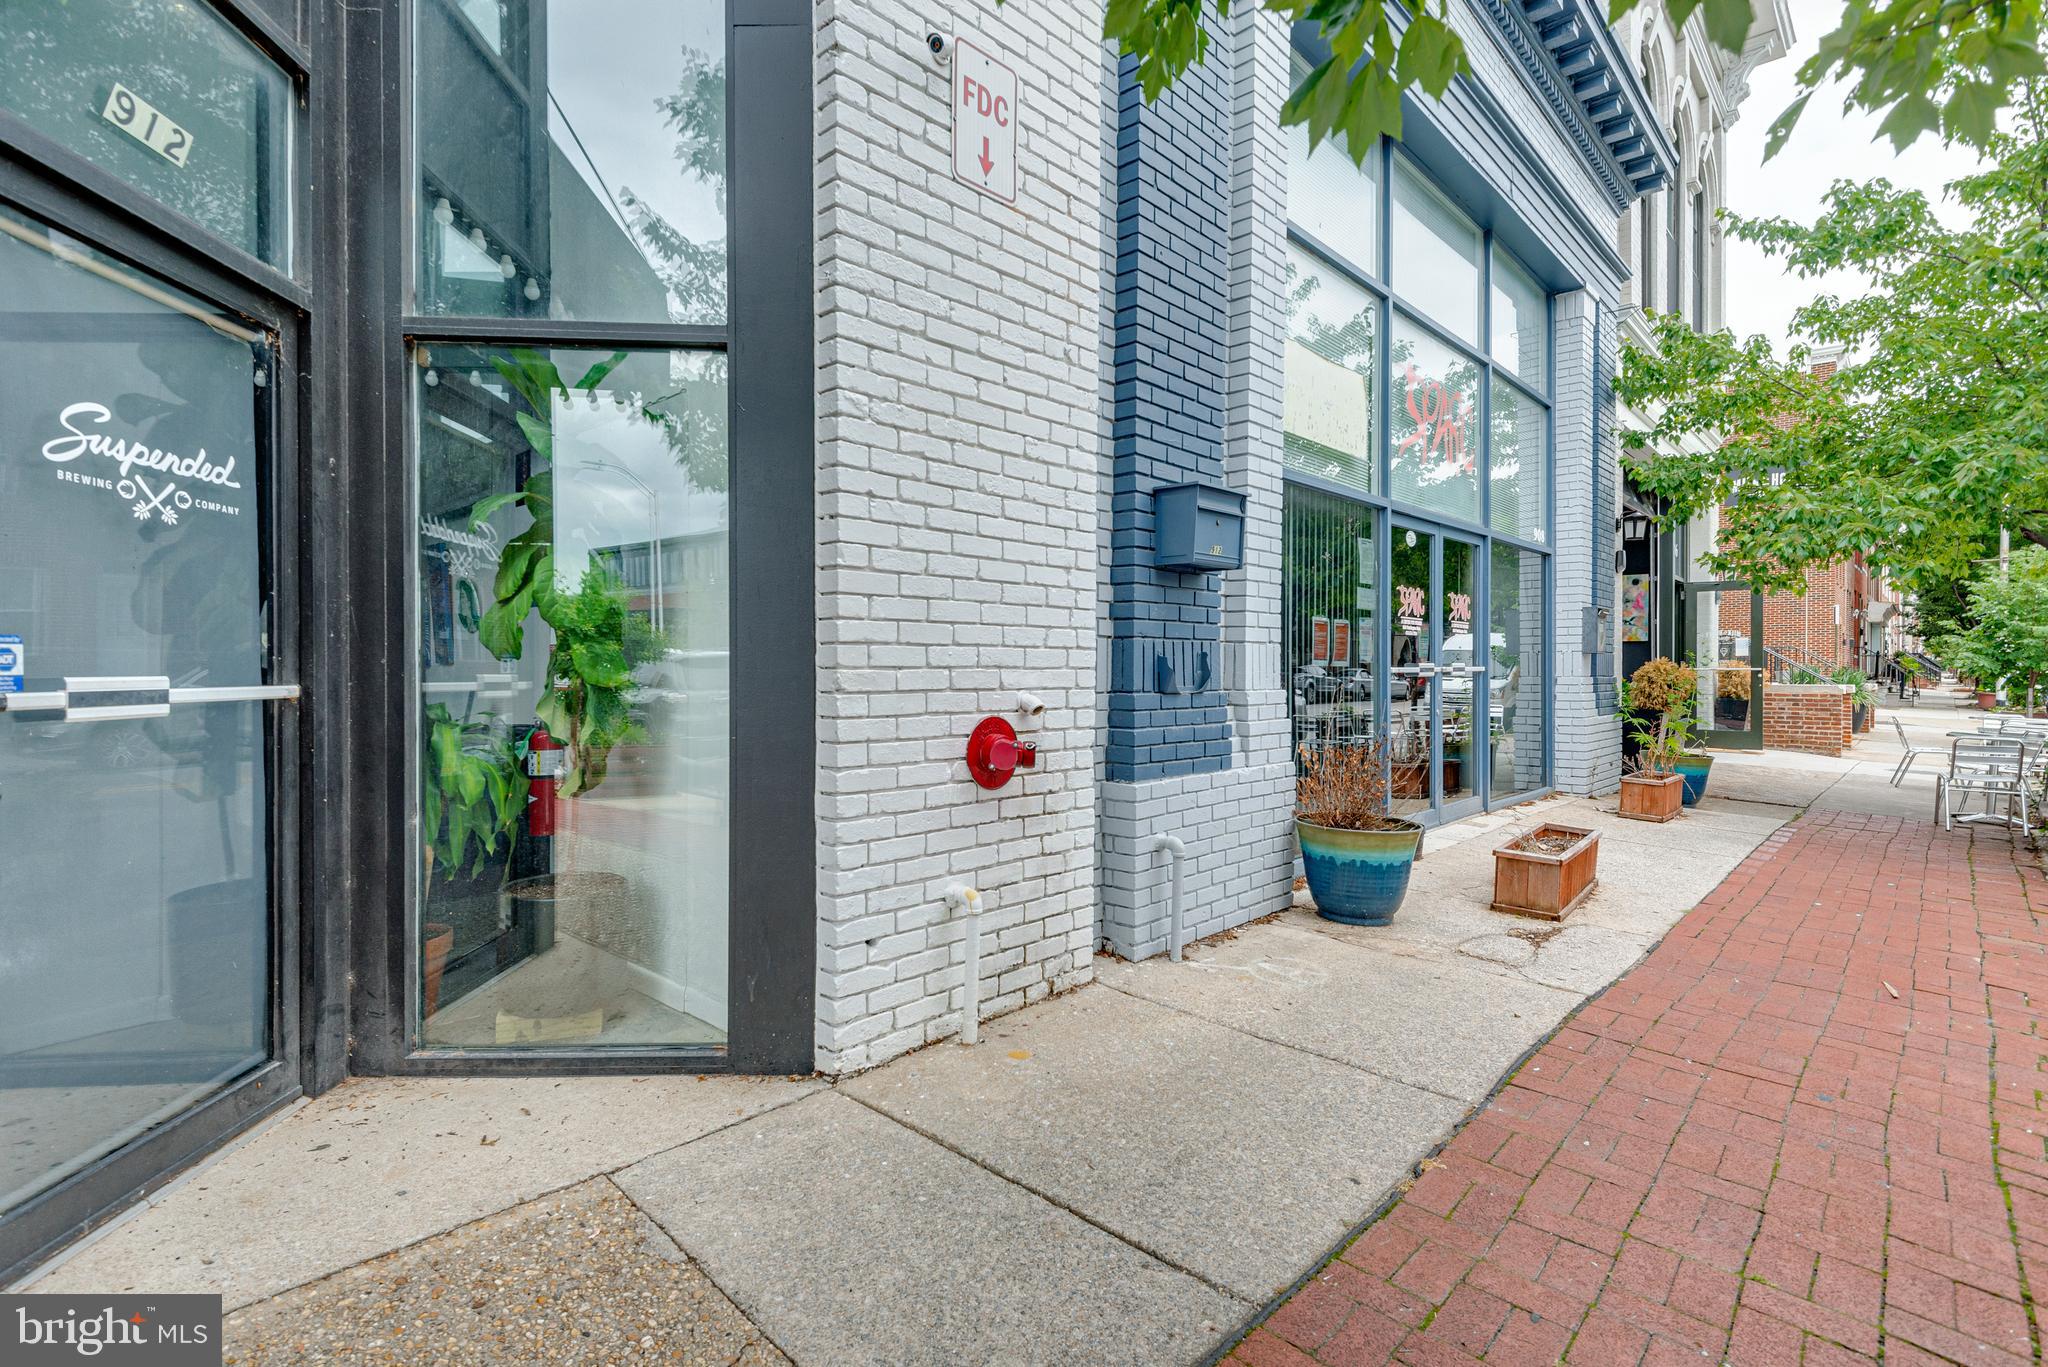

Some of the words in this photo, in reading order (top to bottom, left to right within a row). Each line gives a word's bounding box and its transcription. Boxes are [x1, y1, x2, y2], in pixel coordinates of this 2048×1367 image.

[111, 89, 186, 162] 912
[963, 75, 1009, 128] FDC
[42, 402, 241, 489] Suspended
[56, 469, 114, 491] BREWING
[194, 499, 241, 516] COMPANY
